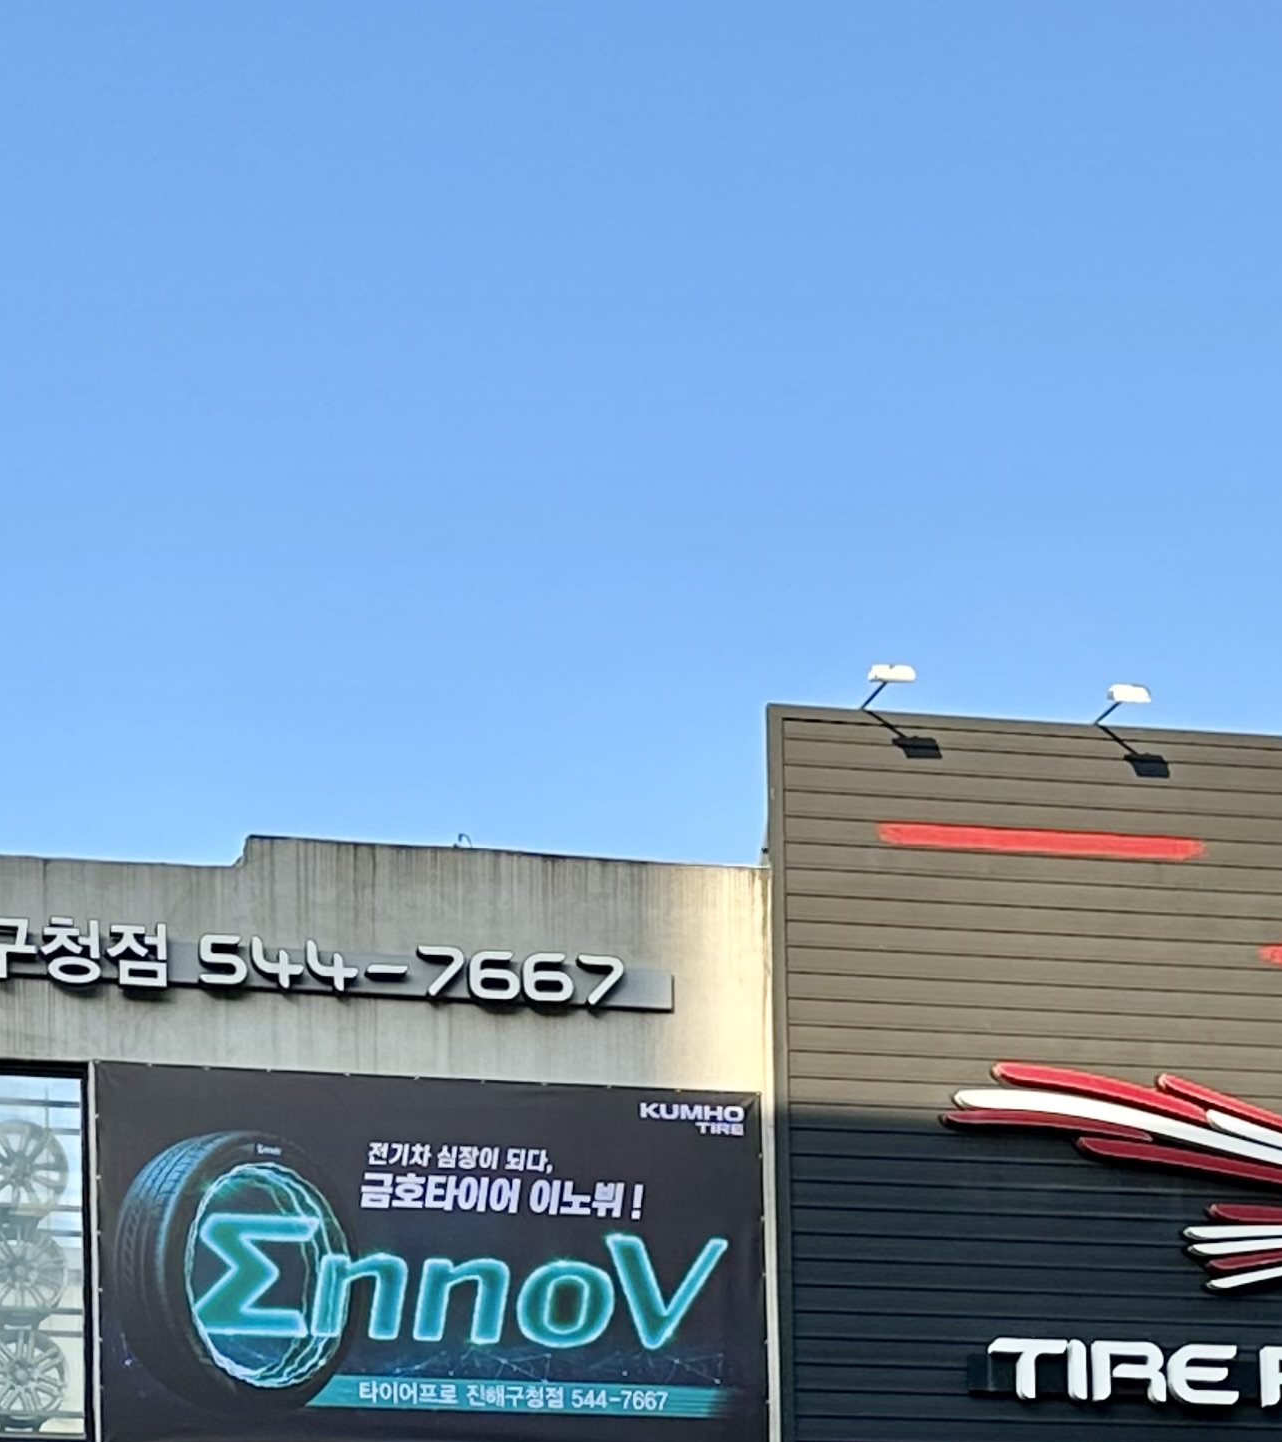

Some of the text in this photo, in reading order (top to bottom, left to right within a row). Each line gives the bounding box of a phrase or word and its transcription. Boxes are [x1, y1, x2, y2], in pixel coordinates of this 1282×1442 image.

[199, 933, 626, 1005] 544-7667
[640, 1102, 744, 1123] KUMHO
[697, 1122, 744, 1136] TIRE
[368, 1142, 554, 1175] 전기차 심장이 되다,
[361, 1172, 521, 1214] 금호타이어
[988, 1336, 1239, 1405] TIRE
[359, 1380, 668, 1411] 타이어프로 진해구청점 544-7667
